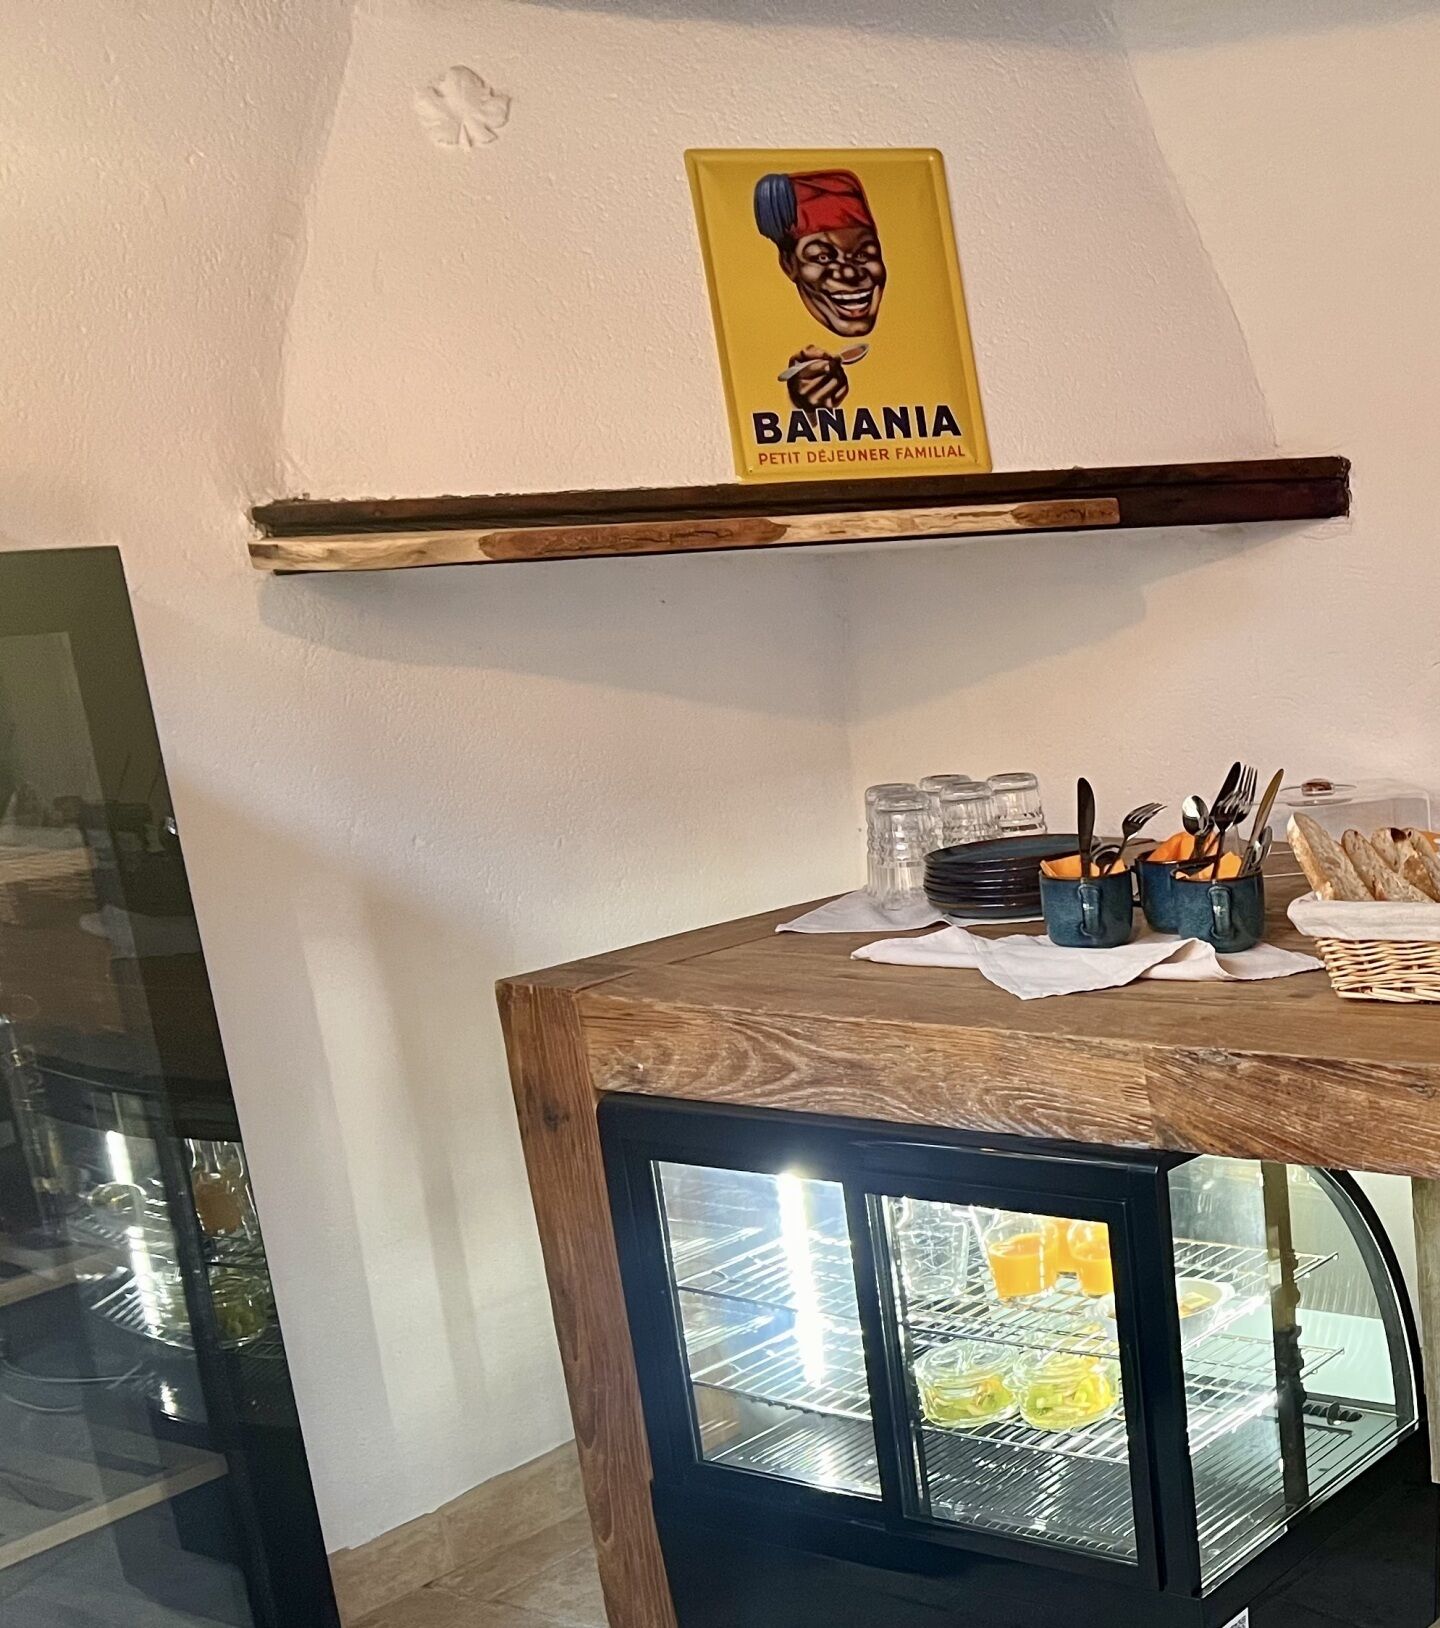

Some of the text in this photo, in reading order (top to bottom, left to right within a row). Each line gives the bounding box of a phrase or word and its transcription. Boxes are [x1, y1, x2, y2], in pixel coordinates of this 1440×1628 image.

[752, 405, 962, 444] BANANIA
[758, 444, 966, 465] PETIT DÉJEUNER FAMILIAL
